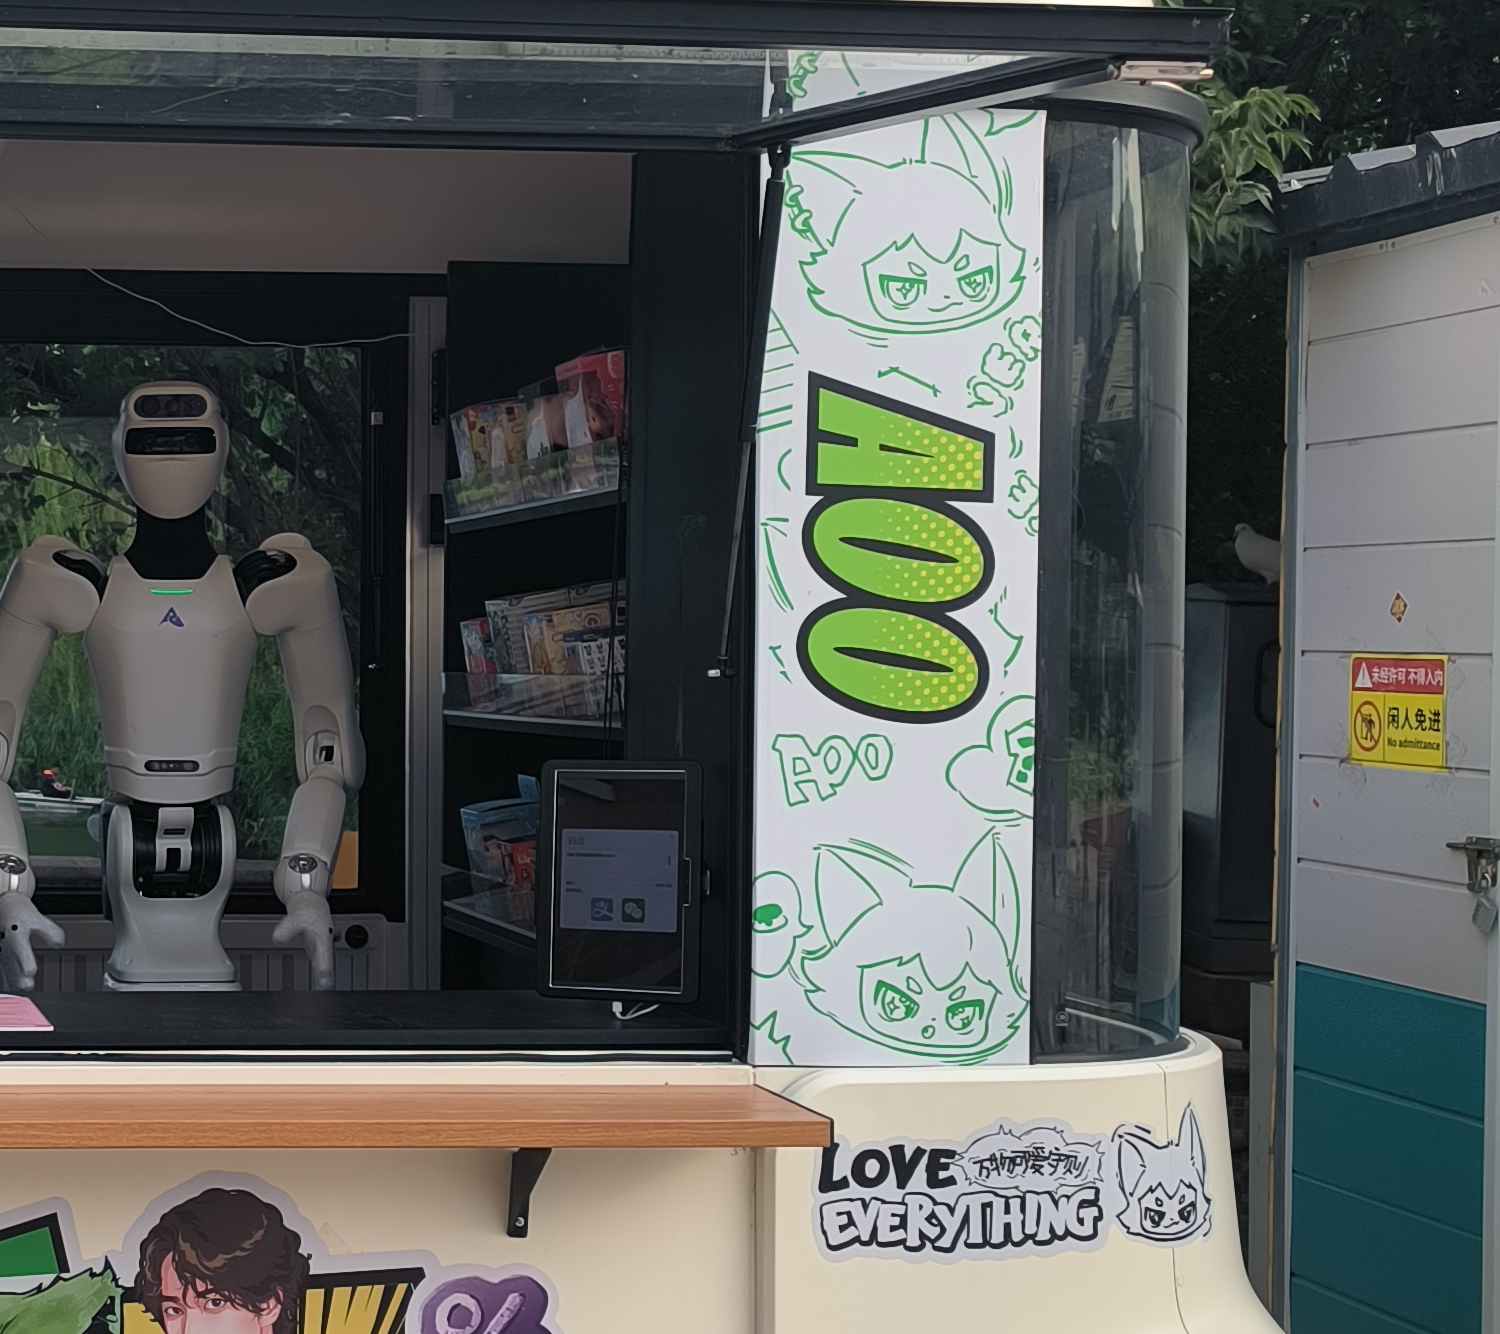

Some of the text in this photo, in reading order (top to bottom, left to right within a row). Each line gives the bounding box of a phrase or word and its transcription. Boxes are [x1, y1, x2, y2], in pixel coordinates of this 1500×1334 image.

[797, 371, 997, 724] AOO
[1372, 666, 1443, 686] 未经许可 不得入内
[1388, 707, 1441, 732] 闲人免进
[1388, 737, 1440, 750] No admittance
[819, 1142, 958, 1193] LOVE
[820, 1187, 1104, 1253] EVERYTHING
